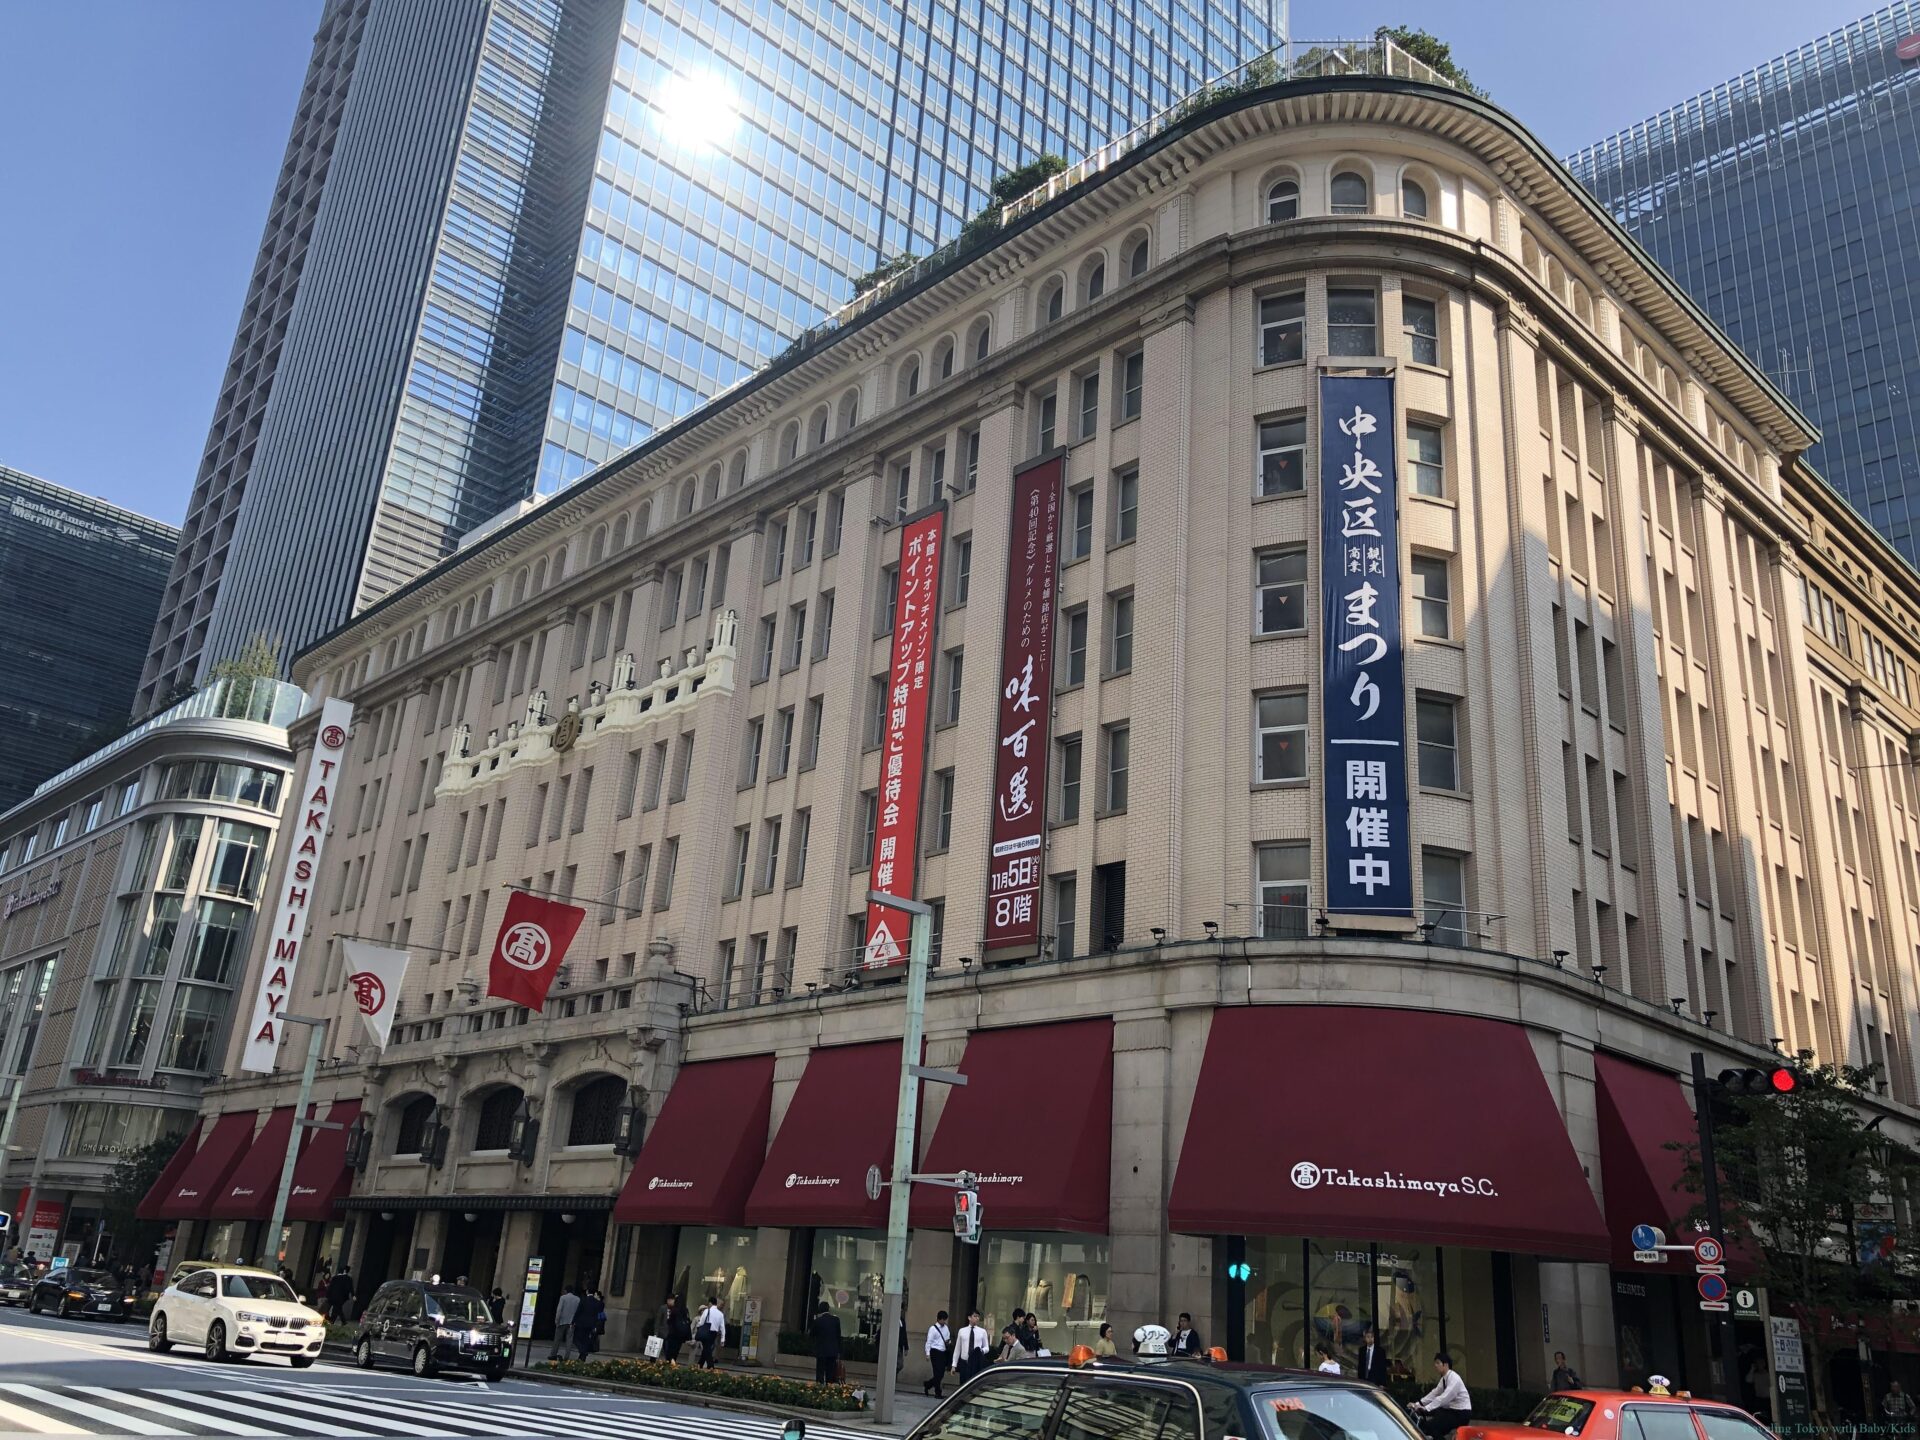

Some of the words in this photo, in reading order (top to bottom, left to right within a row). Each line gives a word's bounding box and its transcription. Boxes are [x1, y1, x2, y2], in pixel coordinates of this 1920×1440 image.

[1338, 405, 1383, 537] 中央区
[12, 506, 53, 527] Merrill
[55, 519, 90, 540] Lynch
[1367, 546, 1382, 574] 観光
[1338, 581, 1388, 721] まつり
[883, 534, 924, 827] ポイントアップ特別ご優待会
[1346, 760, 1390, 895] 開催中
[992, 856, 1031, 891] 11月5日
[254, 759, 336, 1044] TAKASHIMAYA
[995, 894, 1032, 927] 8階
[657, 1178, 694, 1189] Takashimaya
[796, 1175, 841, 1187] Takashimaya
[974, 1172, 1023, 1186] kashimaya
[1322, 1168, 1460, 1196] Takashimaya
[1460, 1176, 1499, 1197] S.C.
[1701, 1245, 1717, 1257] 30
